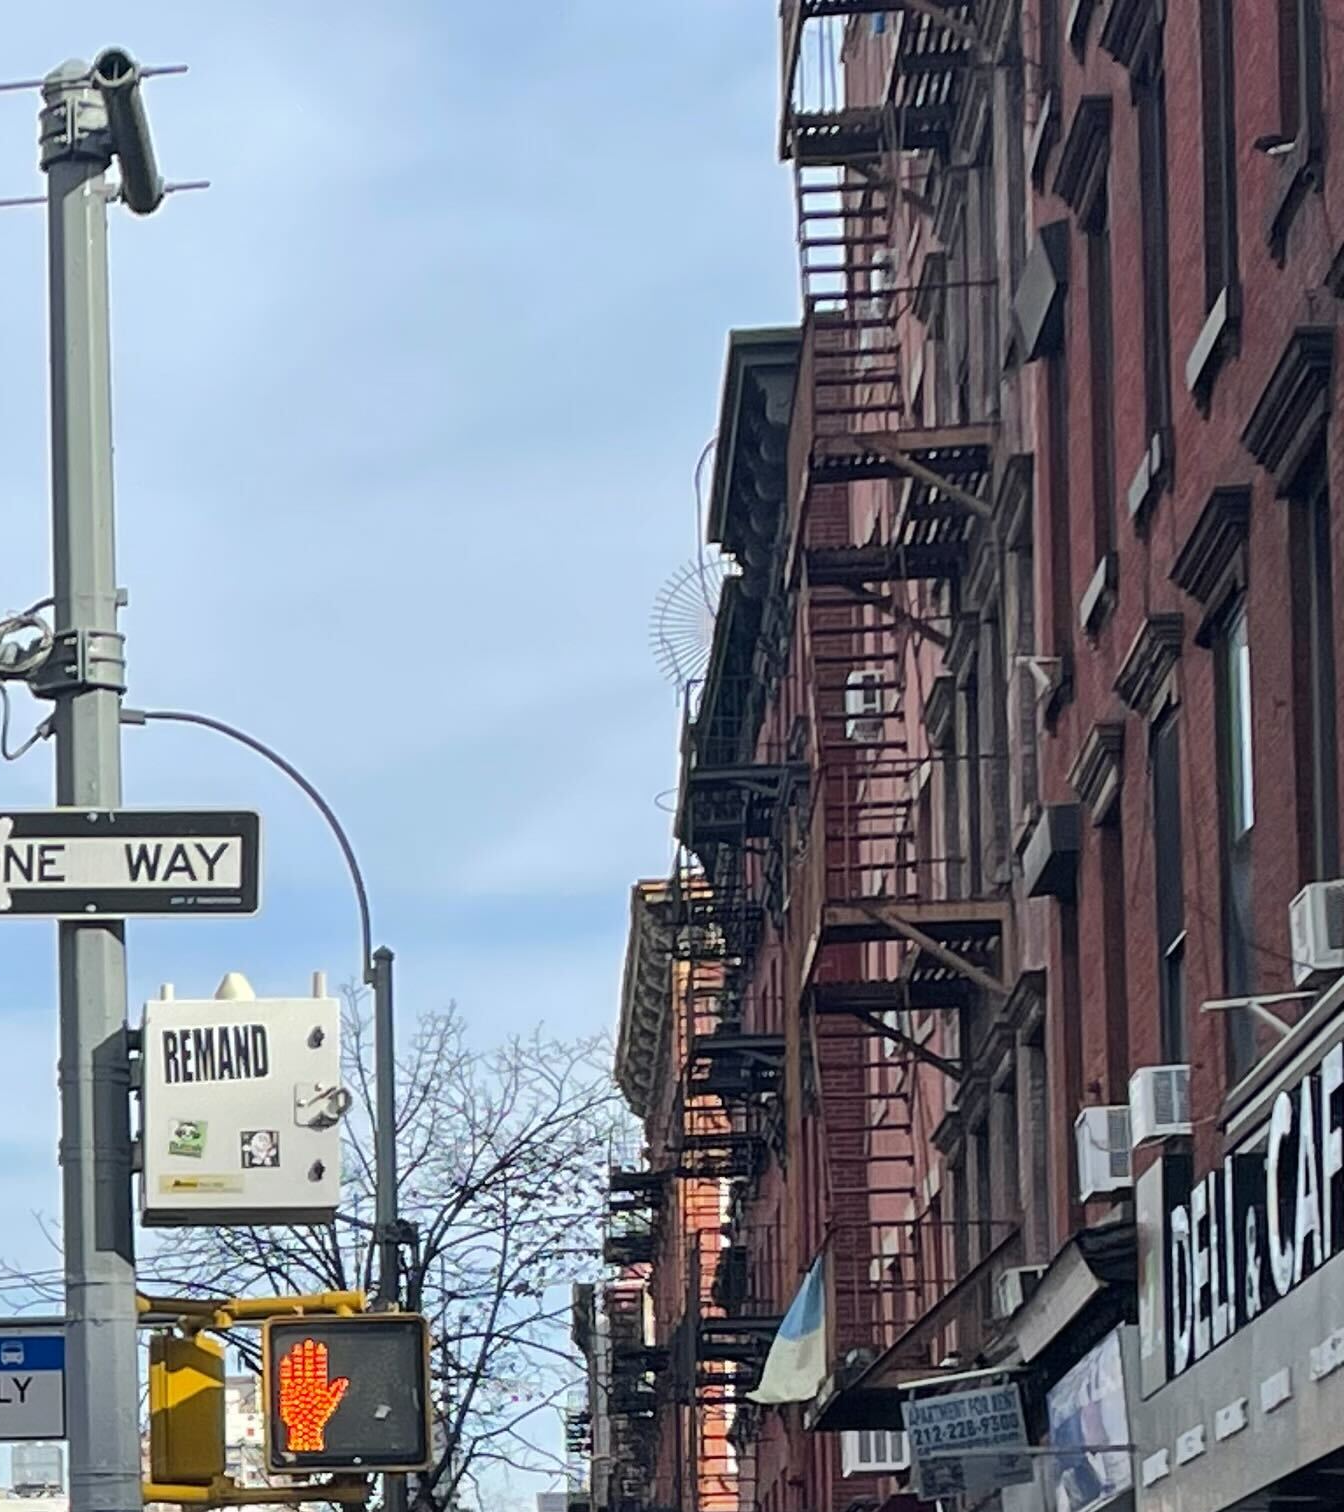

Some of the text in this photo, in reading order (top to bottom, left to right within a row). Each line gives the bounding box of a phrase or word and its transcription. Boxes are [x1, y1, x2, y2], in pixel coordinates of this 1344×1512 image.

[123, 842, 230, 882] WAY
[161, 1023, 270, 1085] REMAND
[1170, 1155, 1238, 1378] DELI
[1245, 1204, 1263, 1320] &
